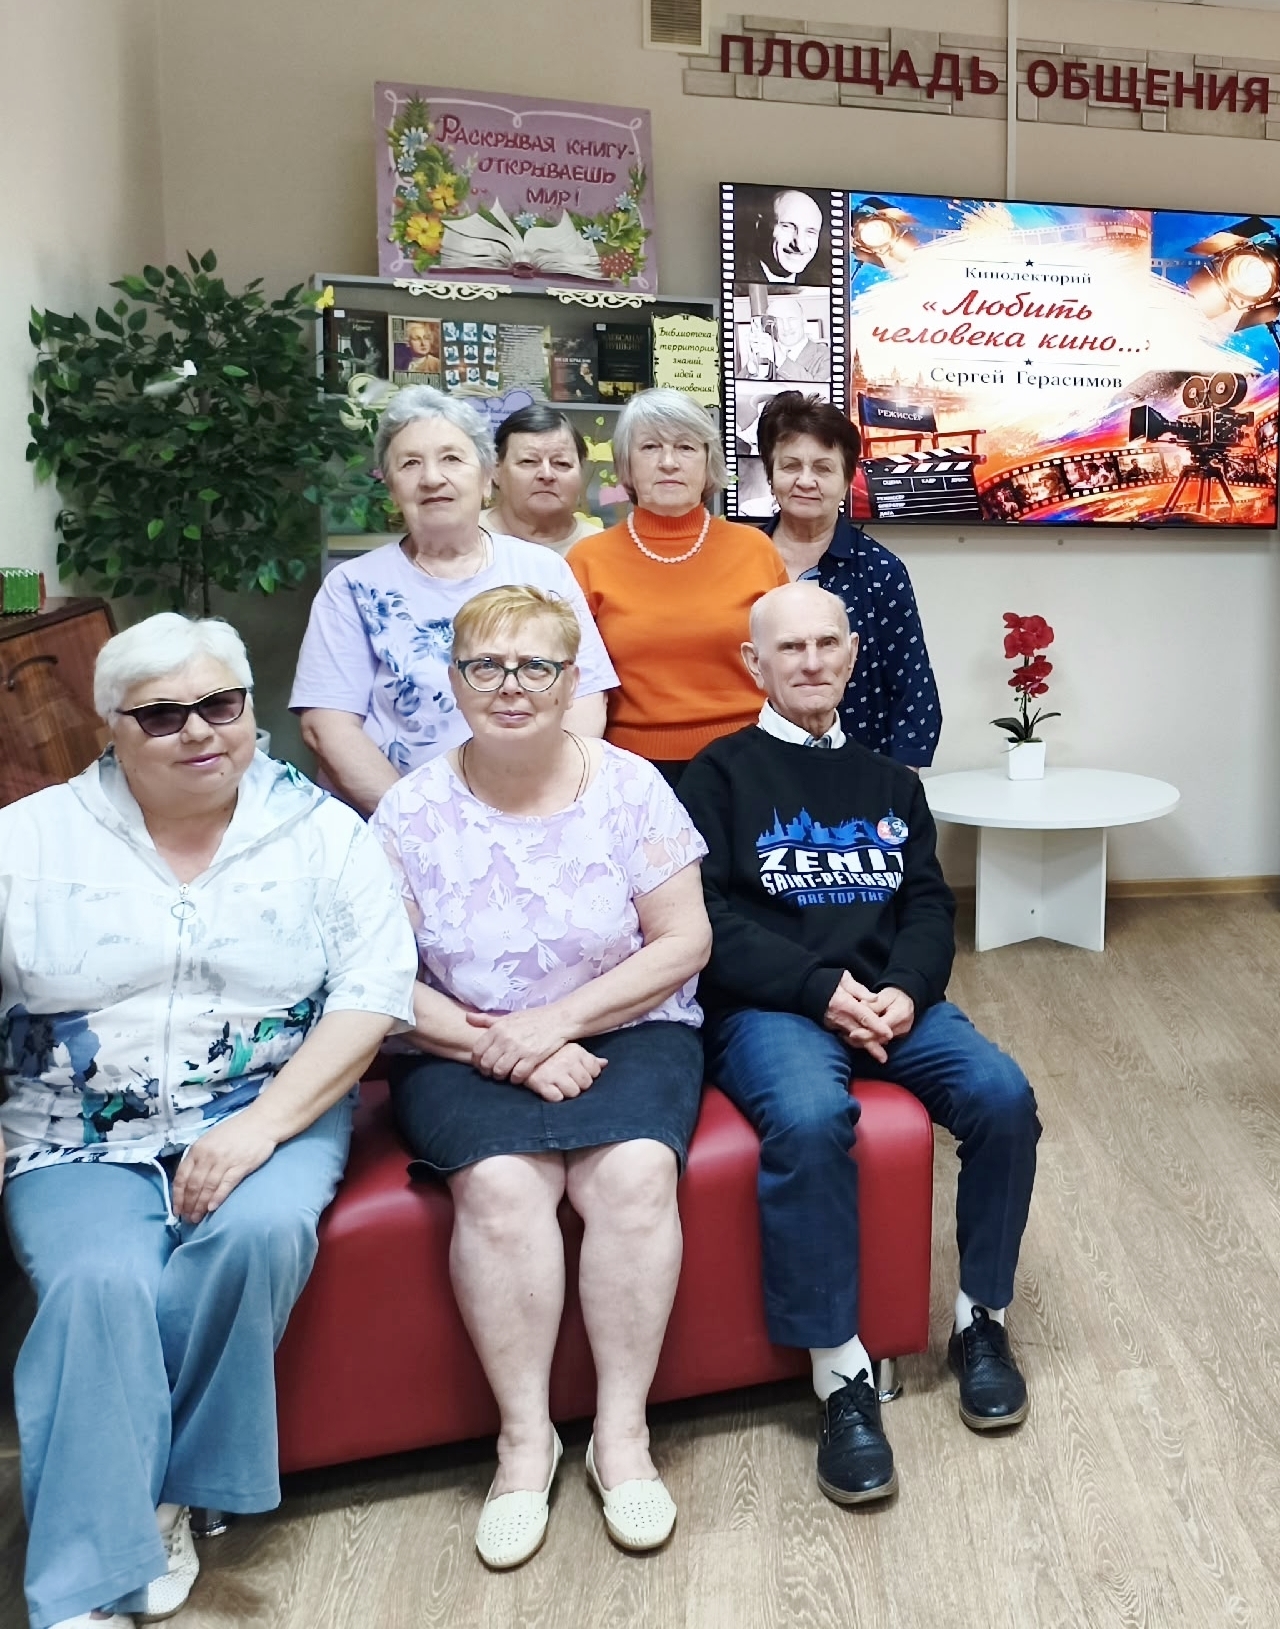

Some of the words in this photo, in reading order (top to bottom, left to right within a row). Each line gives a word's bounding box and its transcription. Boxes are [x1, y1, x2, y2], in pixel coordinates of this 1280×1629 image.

[720, 34, 999, 101] ПЛОЩАДЬ
[1027, 59, 1270, 114] ОБЩЕНИЯ
[478, 157, 616, 184] ОТКРЫВАЕШЬ
[964, 267, 1092, 286] Кинолекторий
[871, 323, 1025, 348] человека
[659, 344, 715, 353] территория
[674, 368, 694, 379] идей
[930, 367, 1005, 386] Сергей
[1016, 371, 1122, 389] Герасимов
[797, 894, 826, 907] ARE
[828, 892, 855, 904] TOP
[859, 891, 885, 902] THE
